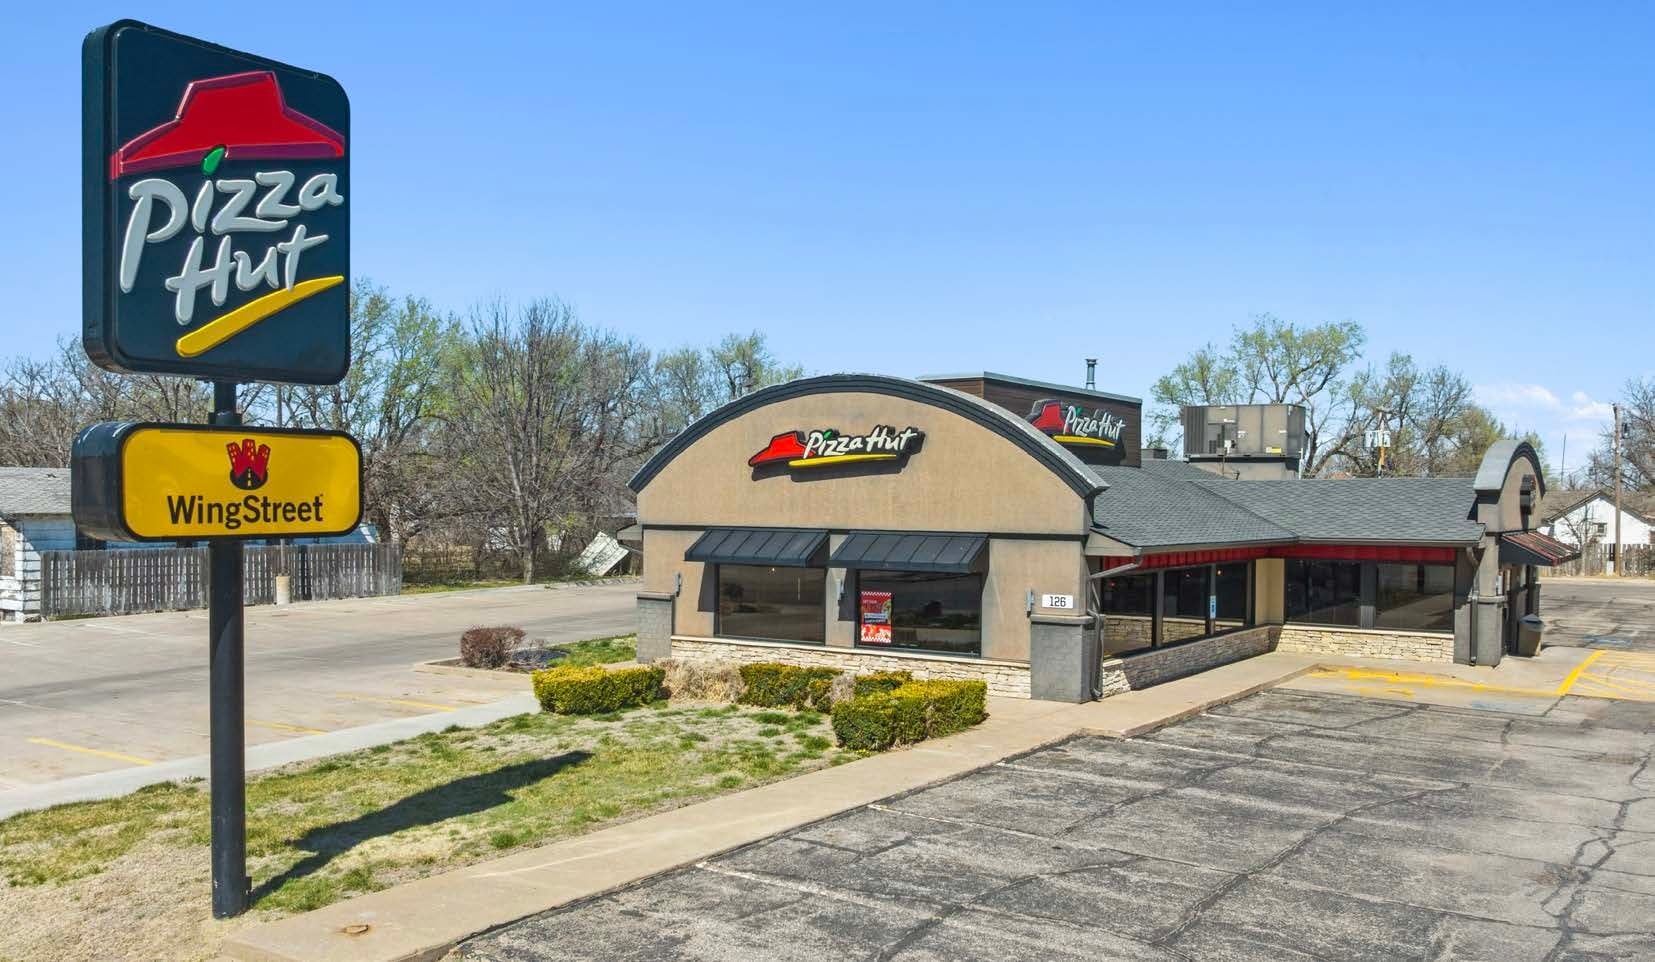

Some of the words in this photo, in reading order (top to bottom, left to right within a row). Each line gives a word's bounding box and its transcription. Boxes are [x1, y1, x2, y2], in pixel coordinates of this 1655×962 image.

[120, 168, 344, 293] Pizza
[165, 224, 329, 325] Hut
[1062, 405, 1098, 437] Pizza
[1098, 412, 1126, 440] Hut
[803, 430, 863, 459] Pizza
[866, 427, 917, 452] Hut
[167, 494, 323, 529] WingStreet
[1049, 596, 1066, 607] 126
